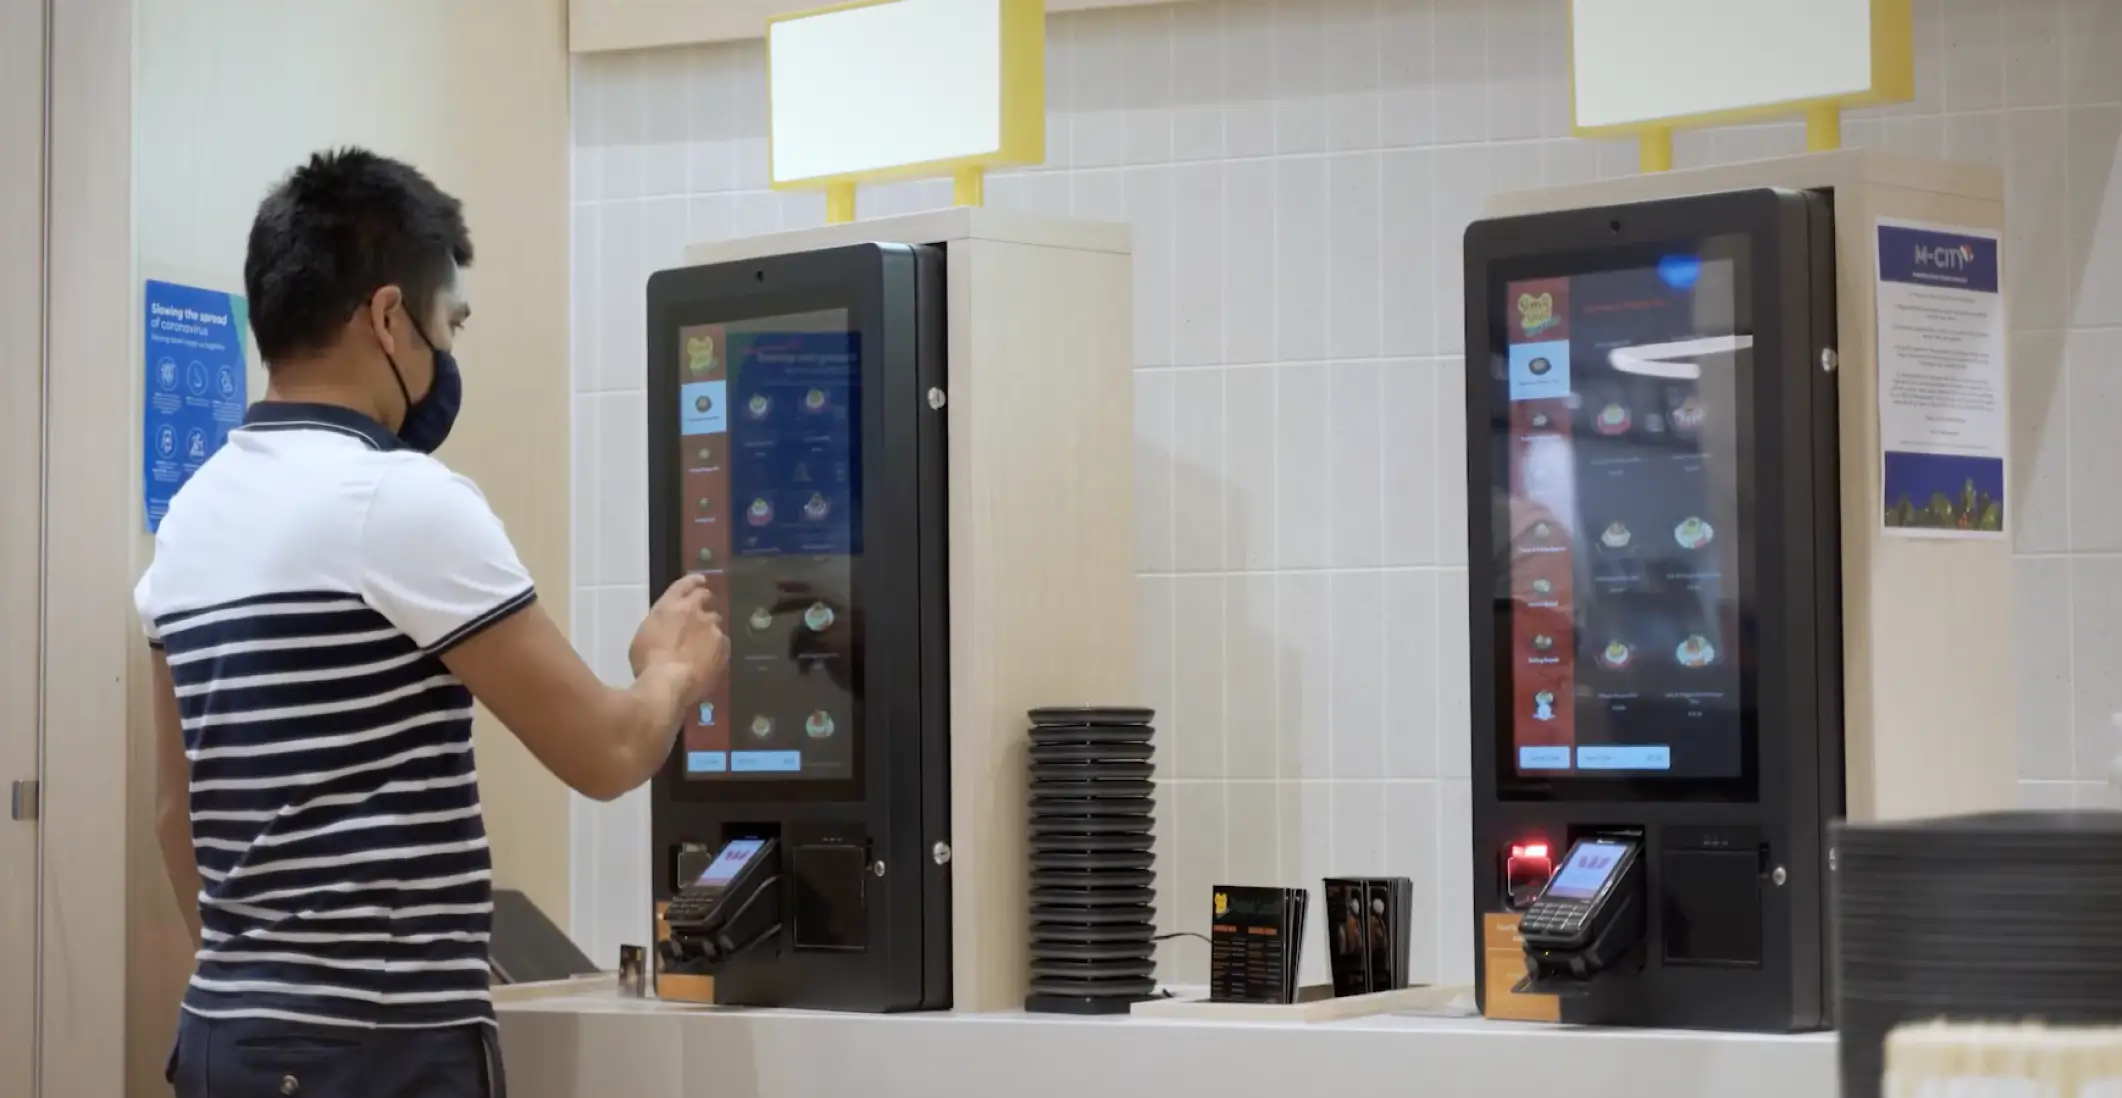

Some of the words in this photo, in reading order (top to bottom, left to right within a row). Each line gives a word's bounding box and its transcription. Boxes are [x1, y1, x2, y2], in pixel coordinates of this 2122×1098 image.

[152, 302, 183, 320] Slowing
[184, 308, 199, 320] the
[200, 312, 228, 326] spread
[151, 317, 160, 328] of
[161, 320, 208, 335] coronavirus
